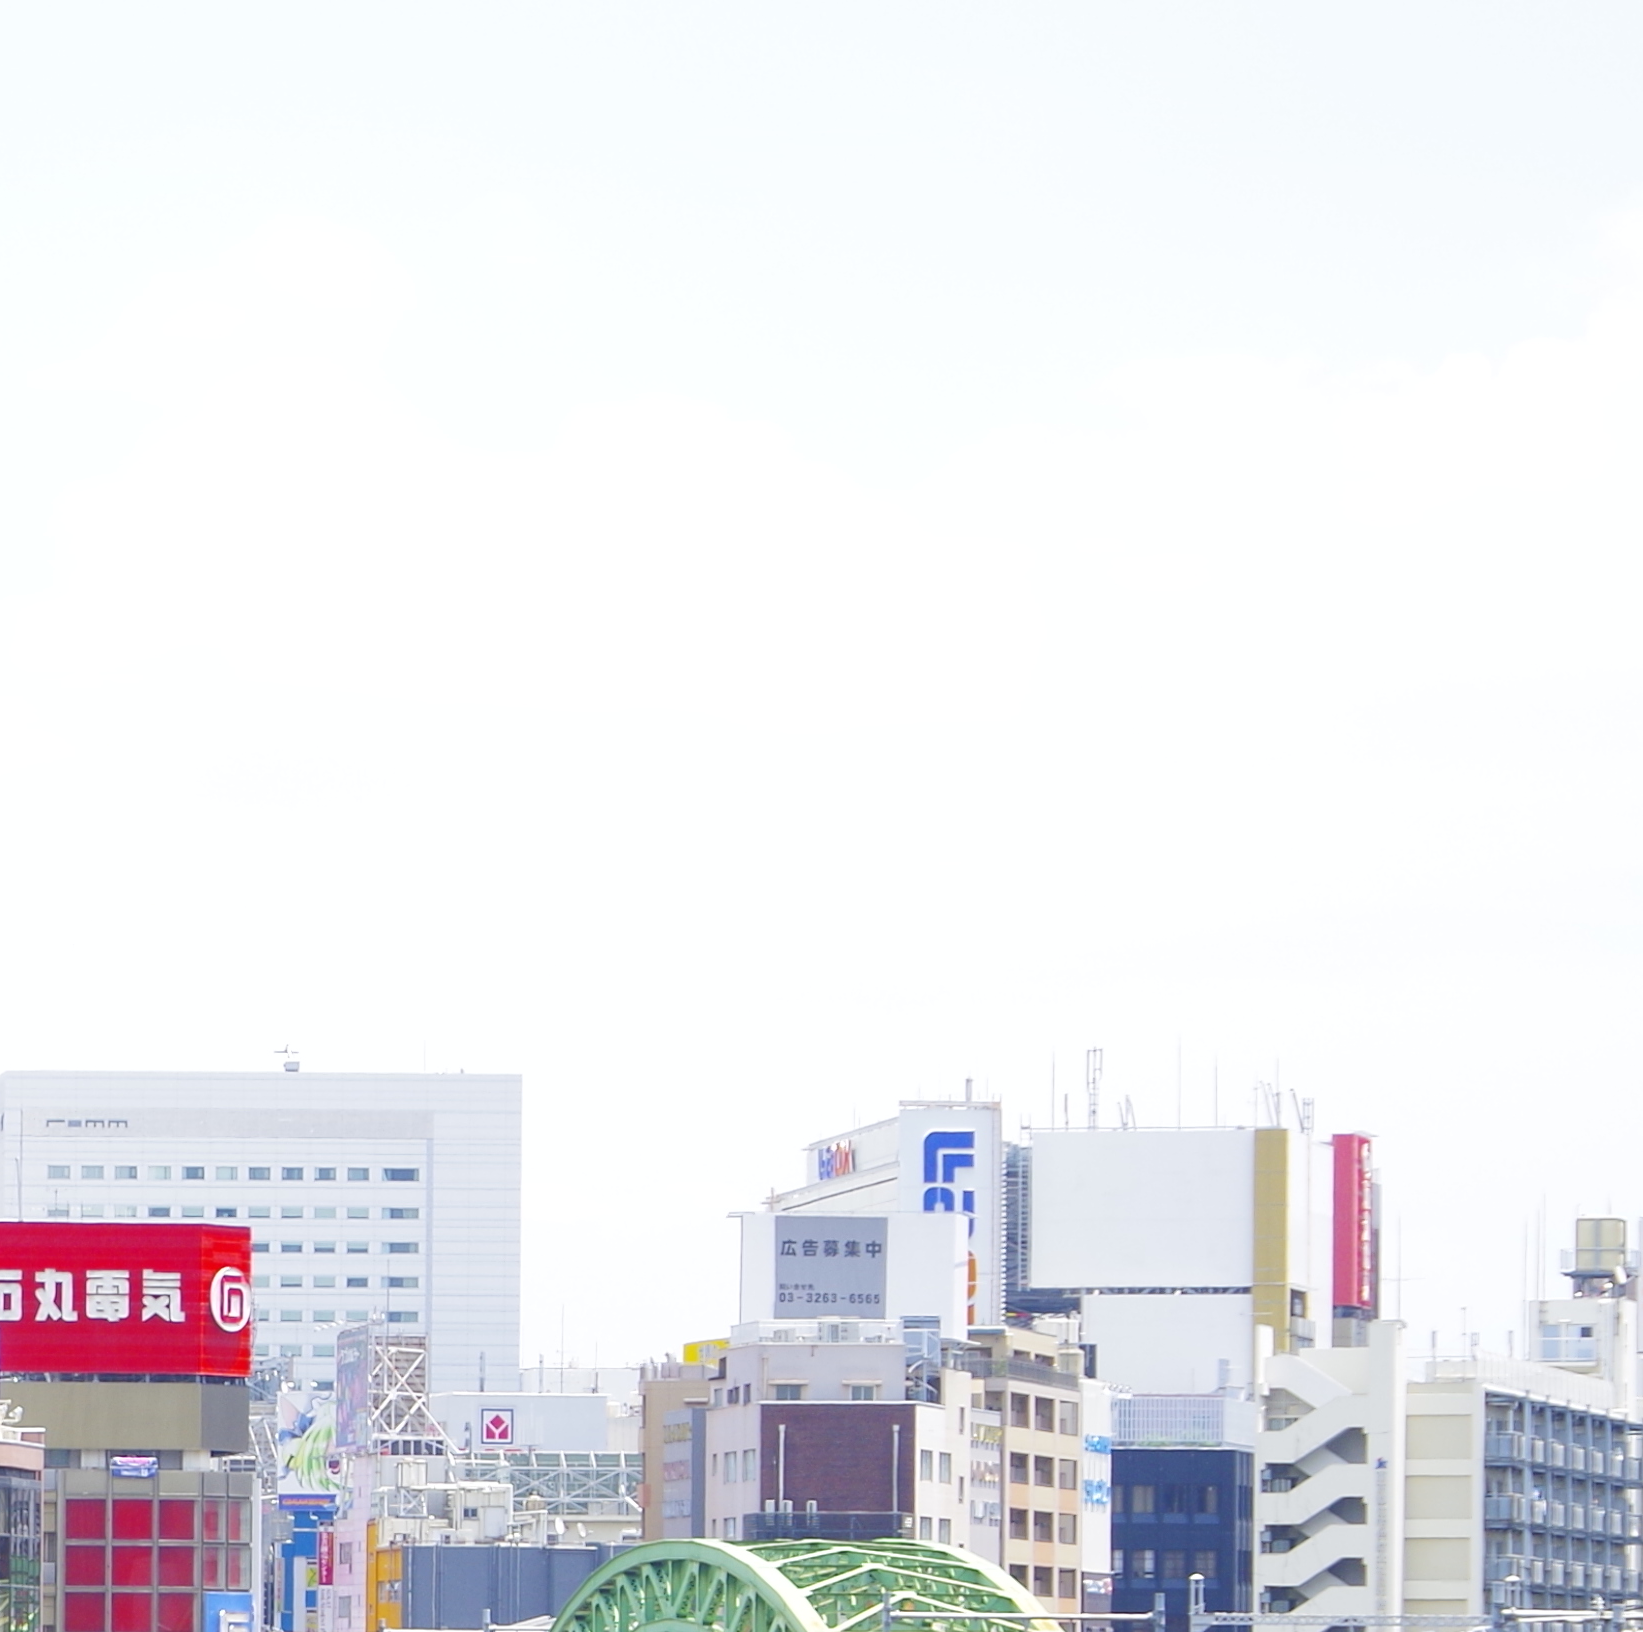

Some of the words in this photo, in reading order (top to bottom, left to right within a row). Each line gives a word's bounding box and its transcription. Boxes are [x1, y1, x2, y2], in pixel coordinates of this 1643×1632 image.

[780, 1239, 882, 1258] 広告募集中
[779, 1292, 881, 1304] 03-3263-6565
